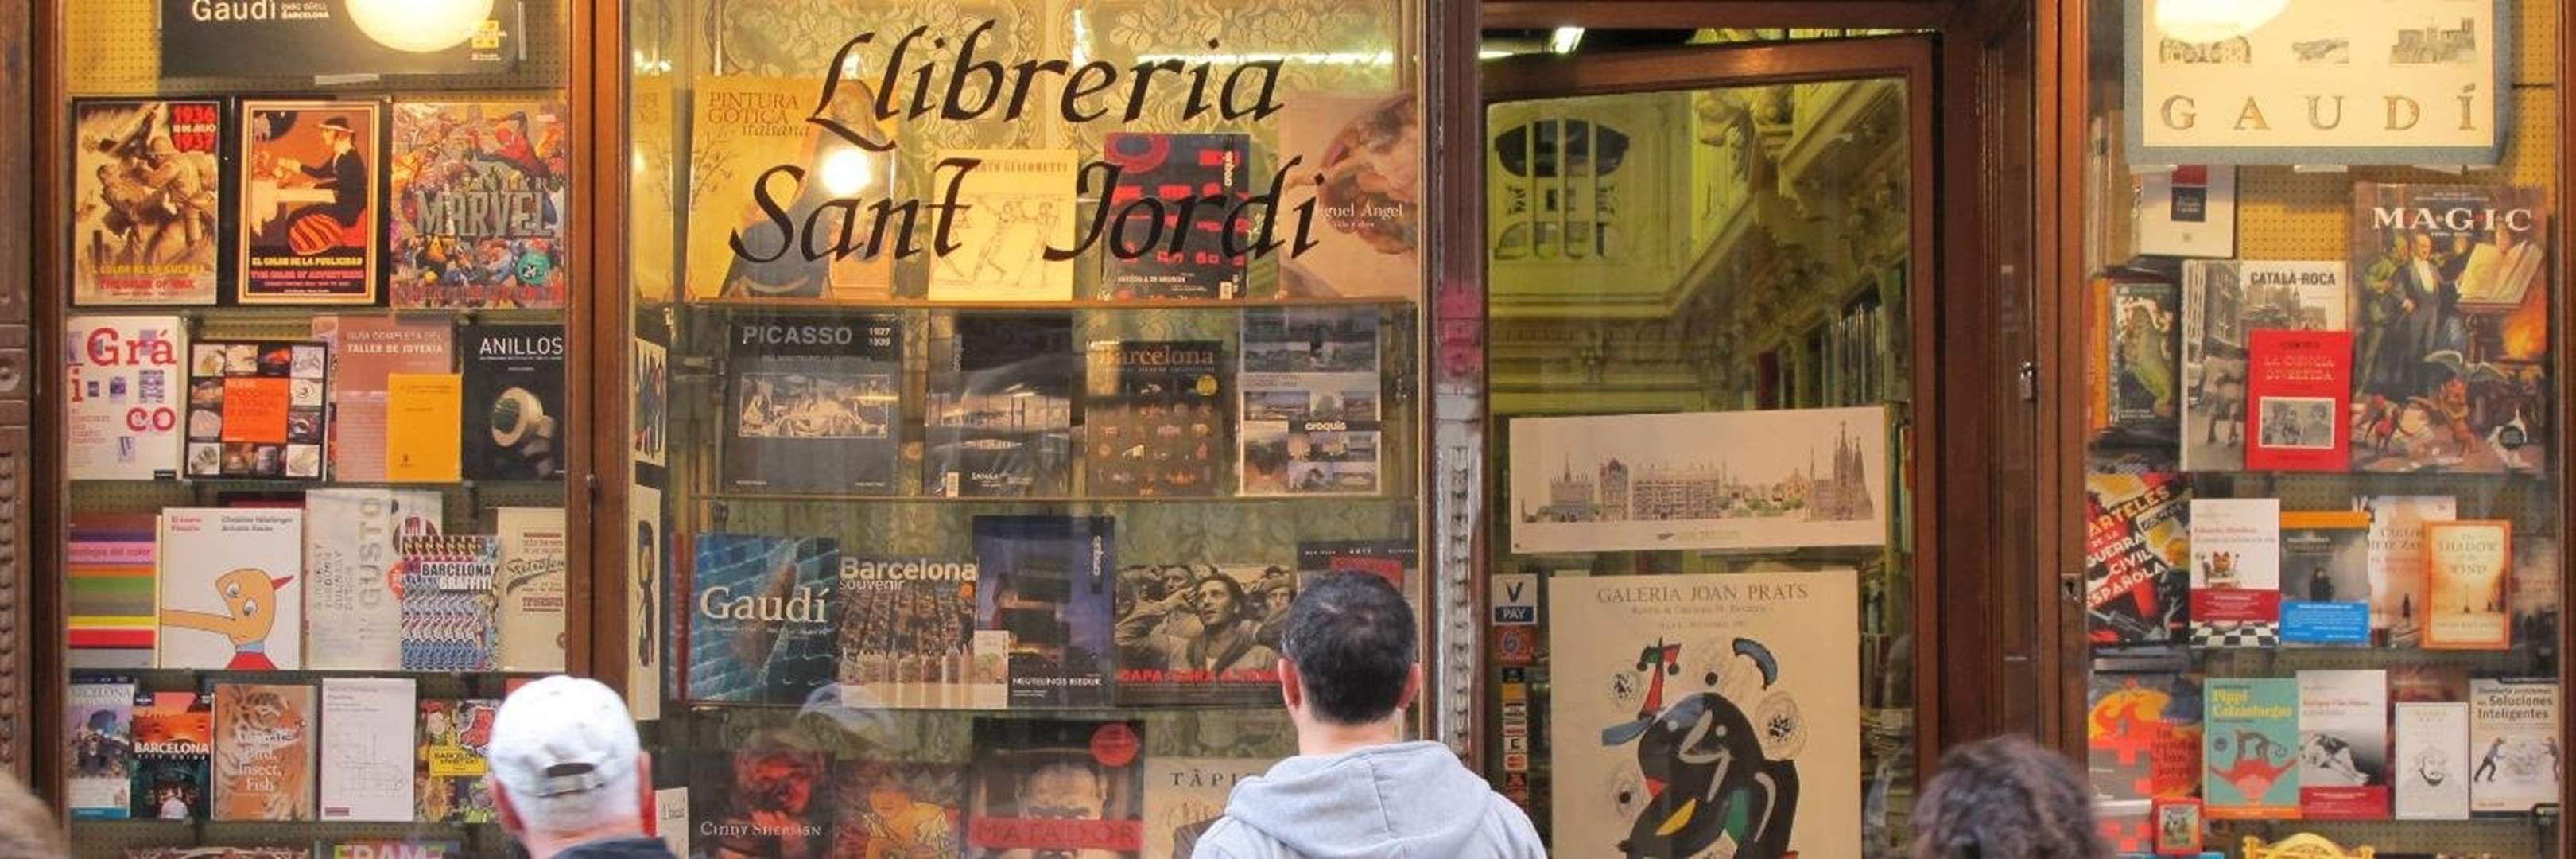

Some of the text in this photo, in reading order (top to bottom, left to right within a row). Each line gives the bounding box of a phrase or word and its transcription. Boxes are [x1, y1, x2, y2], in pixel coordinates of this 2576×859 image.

[281, 10, 330, 19] BARCELONA
[806, 19, 1285, 152] Llibreria
[708, 91, 799, 109] PINTURA
[2159, 83, 2477, 132] GAUDÍ
[174, 105, 216, 123] 1936
[175, 133, 215, 151] 1937
[1224, 150, 1234, 187] croquis
[417, 190, 555, 238] MARVEL
[729, 154, 1322, 263] Sant Jordi
[252, 257, 263, 266] EL
[264, 257, 289, 266] COLOR
[302, 257, 314, 266] LA
[315, 257, 363, 266] PUBLICIDAD
[743, 325, 852, 344] PICASSO
[87, 327, 177, 367] Grá
[347, 343, 383, 353] TALLER
[386, 343, 399, 353] DE
[479, 336, 564, 355] ANILLOS
[1100, 344, 1214, 366] Barcelona
[126, 407, 177, 432] co
[1305, 420, 1348, 433] croquis
[2089, 485, 2170, 538] ARTELES
[359, 497, 382, 611] GUSTO
[2086, 531, 2145, 567] GUERRA
[2438, 540, 2497, 552] SHADOW
[1093, 535, 1104, 577] croquis
[2110, 549, 2154, 575] CIVIL
[421, 563, 491, 577] BARCELONA
[840, 556, 979, 581] Barcelona
[2449, 565, 2487, 575] WIND
[439, 577, 492, 590] GRAFFITI
[839, 578, 906, 592] souvenir
[1506, 581, 1523, 603] V
[1597, 583, 1809, 603] GALERIA JOAN PRATS
[700, 585, 831, 624] Gaudí
[1502, 607, 1526, 620] PAY
[2489, 694, 2553, 707] Soluciones
[2478, 707, 2549, 722] Inteligentes
[134, 741, 210, 755] BARCELONA
[246, 776, 274, 792] Fish
[1170, 768, 1239, 787] TÀPI
[977, 820, 1135, 841] MATADOR
